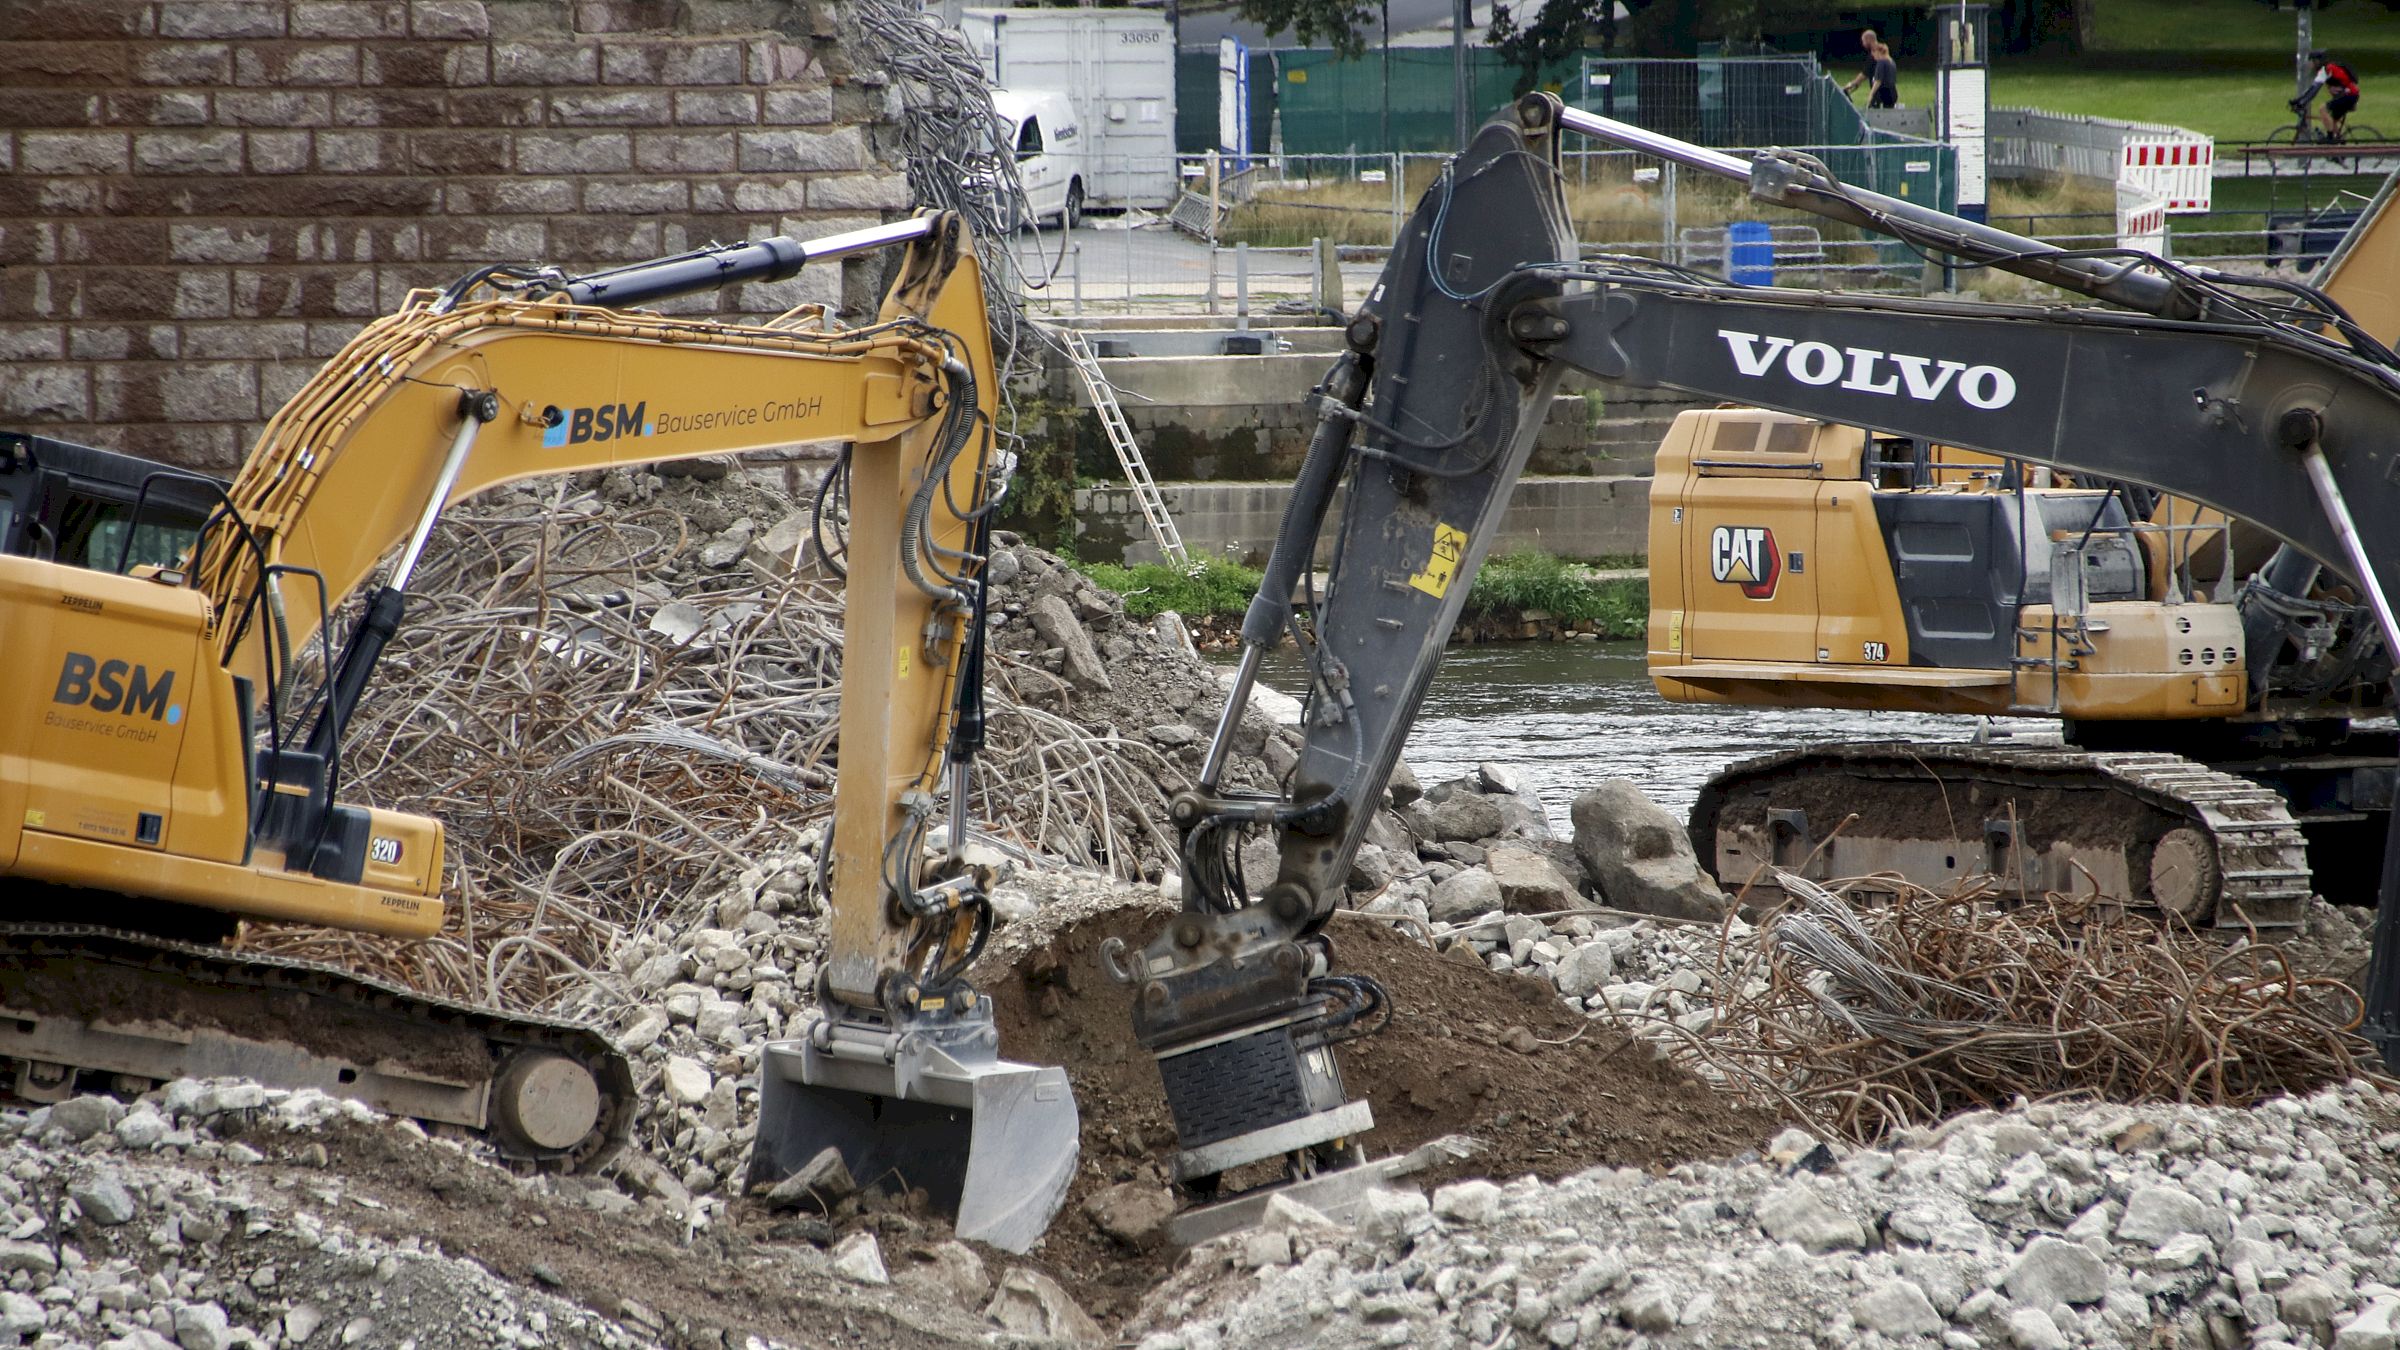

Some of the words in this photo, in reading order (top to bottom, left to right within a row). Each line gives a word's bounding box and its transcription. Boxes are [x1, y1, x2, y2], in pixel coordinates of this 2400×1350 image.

[1120, 31, 1159, 43] 33050
[1717, 329, 2017, 410] VOLVO
[656, 404, 757, 435] Bauservice
[763, 395, 823, 422] GmbH
[1712, 527, 1764, 582] CAT
[1864, 642, 1885, 661] 374
[44, 711, 114, 737] Bauservice
[116, 724, 158, 744] GmbH
[371, 838, 397, 863] 320
[381, 895, 420, 911] ZEPPELIN
